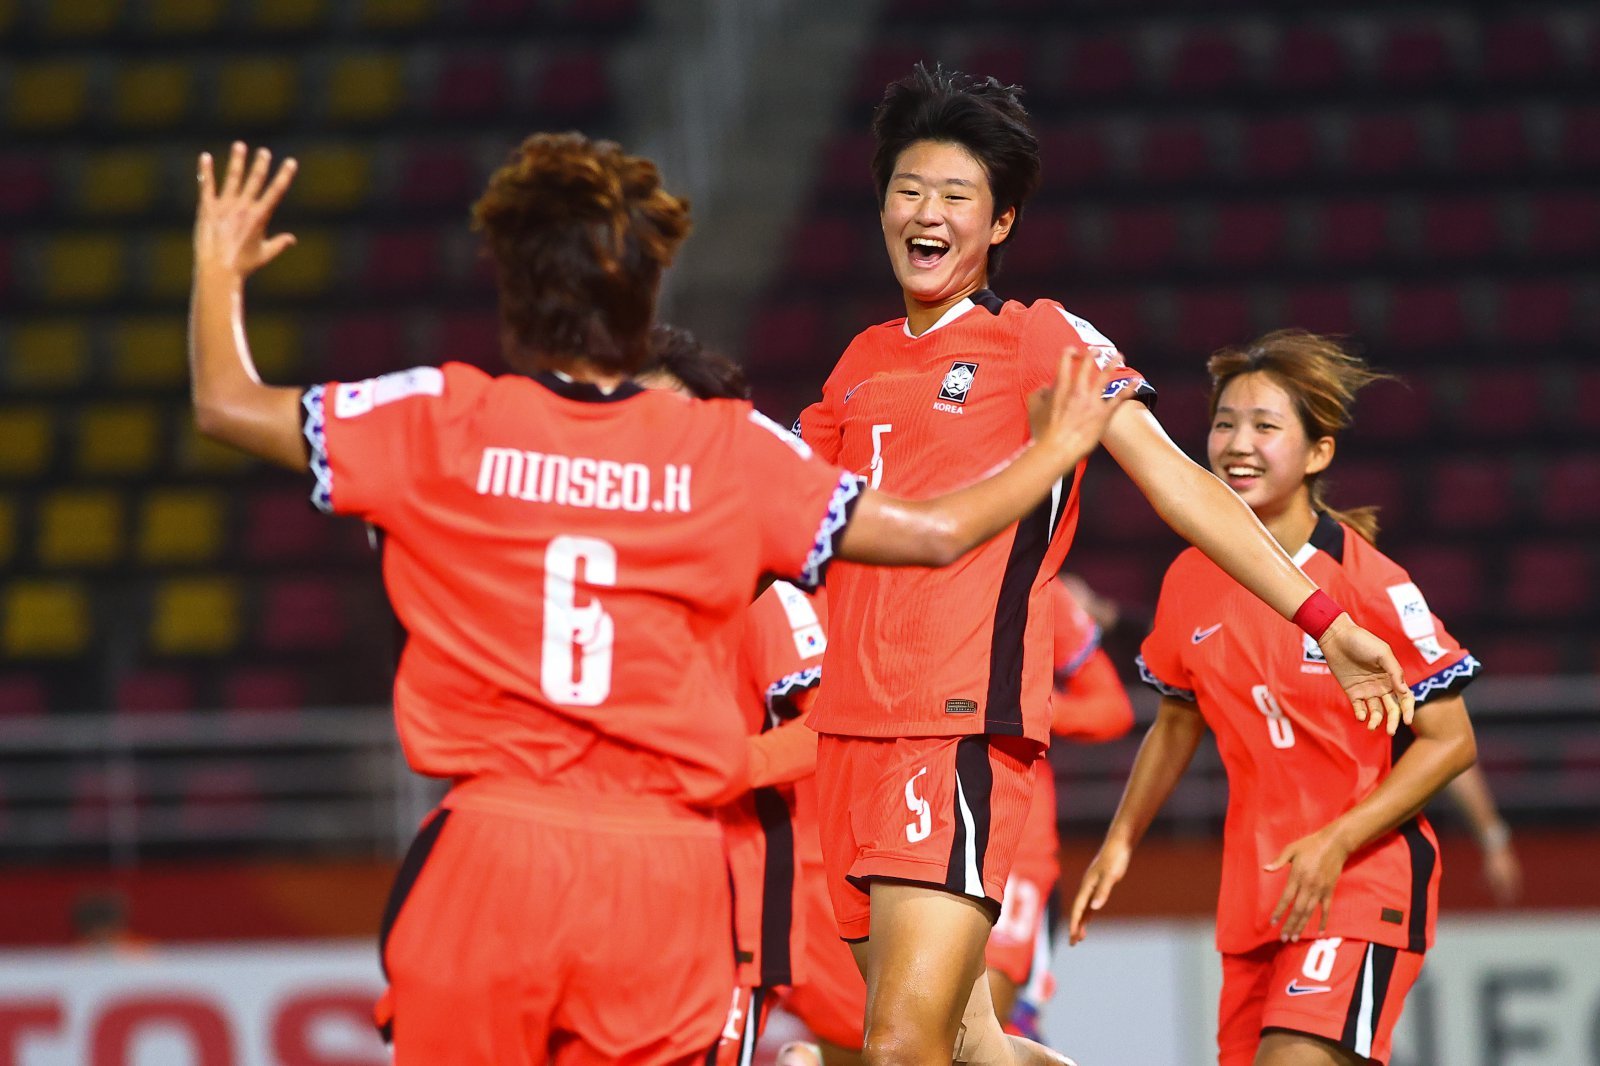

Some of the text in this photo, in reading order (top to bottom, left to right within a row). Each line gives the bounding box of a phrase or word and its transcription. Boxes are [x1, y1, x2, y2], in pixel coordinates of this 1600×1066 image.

[932, 401, 964, 415] KOREA
[475, 446, 692, 513] MINSEO.H
[540, 534, 617, 706] 6
[1251, 684, 1296, 750] 8
[904, 766, 932, 843] 5
[1301, 936, 1343, 982] 8
